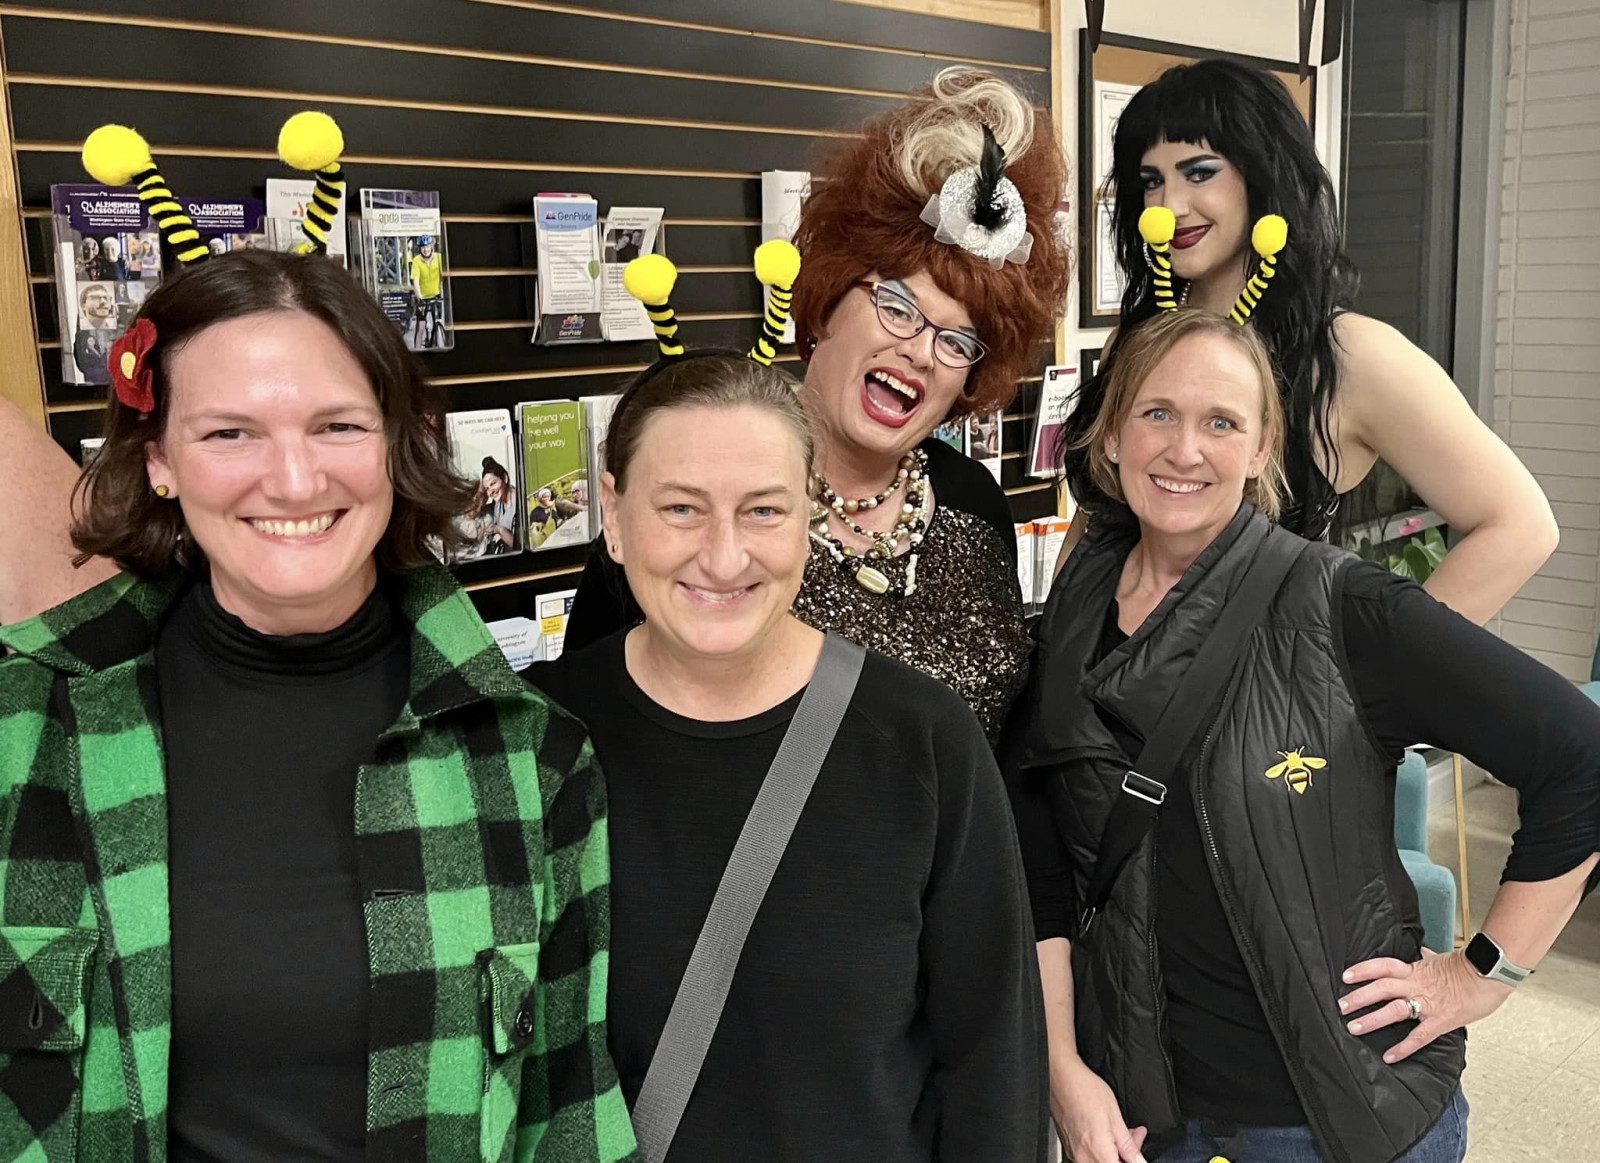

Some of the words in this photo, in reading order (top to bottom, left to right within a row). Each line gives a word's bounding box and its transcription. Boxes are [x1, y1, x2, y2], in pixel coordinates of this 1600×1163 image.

[379, 213, 400, 225] apda
[557, 211, 593, 221] GenPride
[527, 413, 558, 424] helping
[560, 412, 575, 421] you
[528, 427, 541, 437] live
[543, 424, 559, 436] well
[528, 440, 547, 452] your
[549, 437, 566, 448] way
[497, 633, 520, 641] niversity
[501, 640, 526, 648] ashington
